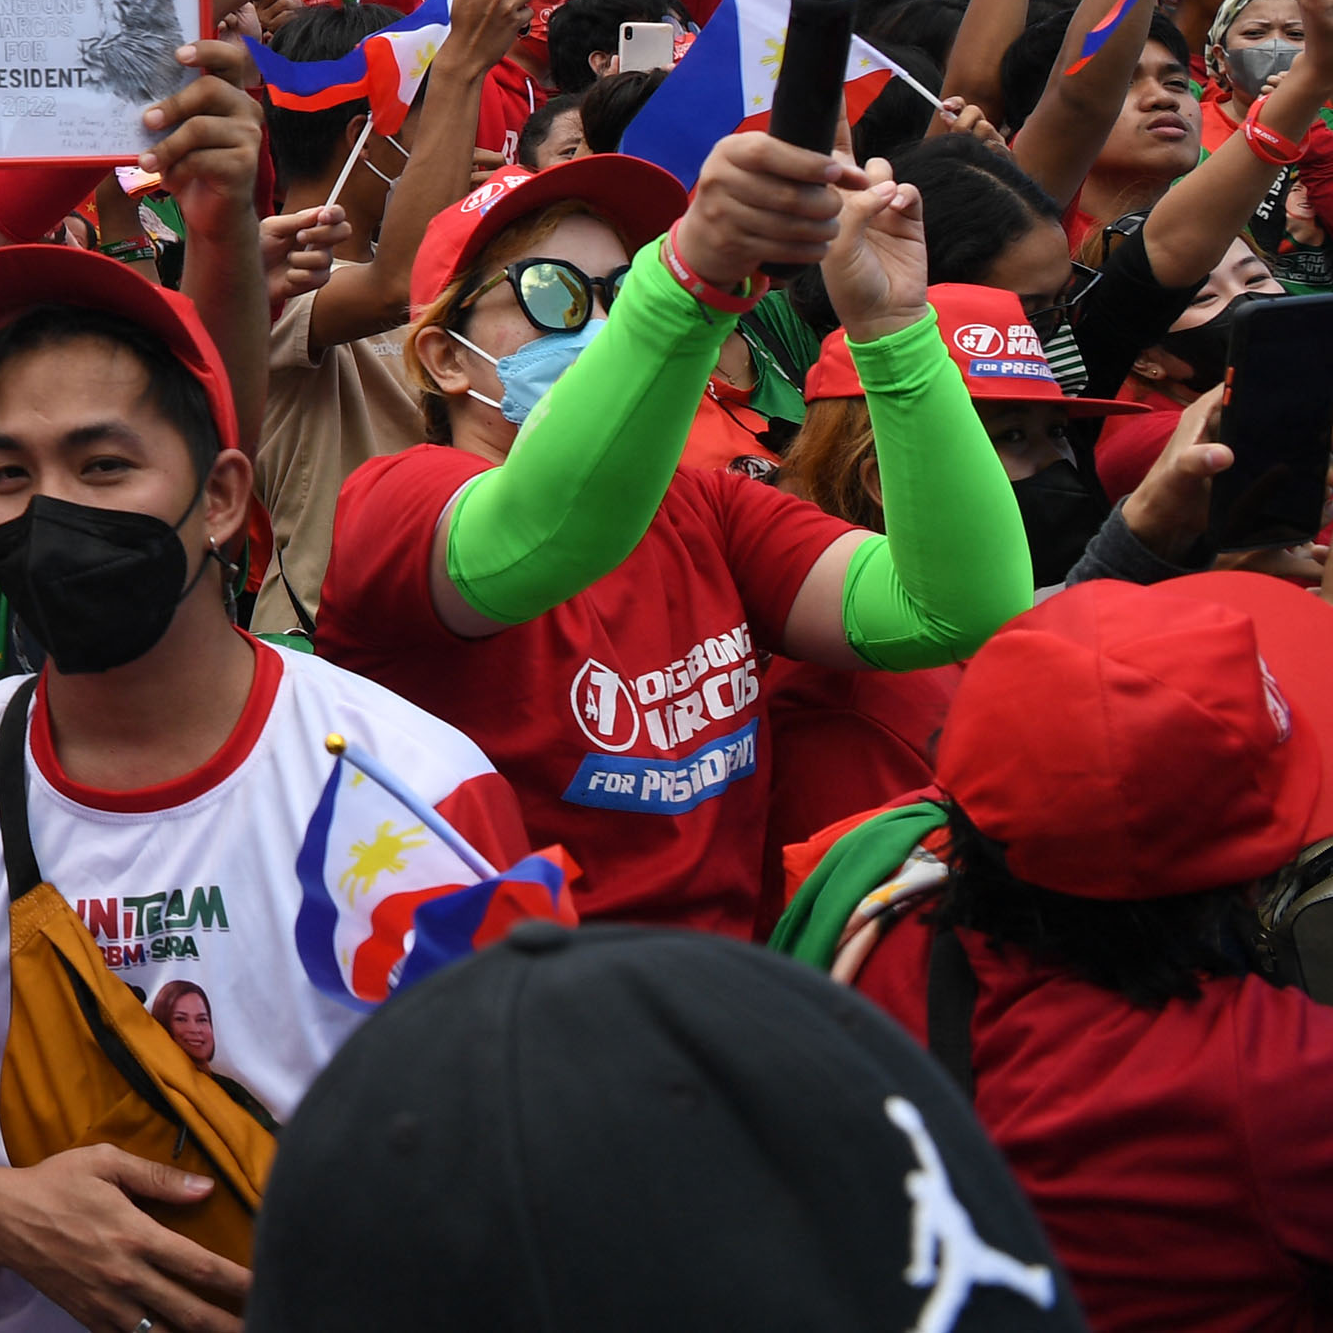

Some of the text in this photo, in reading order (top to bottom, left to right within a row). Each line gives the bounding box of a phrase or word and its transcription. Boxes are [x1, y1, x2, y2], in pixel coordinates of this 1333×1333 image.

[4, 40, 47, 62] FOR
[2, 96, 57, 117] 2022
[1257, 199, 1276, 221] ST.
[961, 327, 996, 352] #7
[975, 363, 998, 371] FOR
[588, 771, 636, 795] FOR
